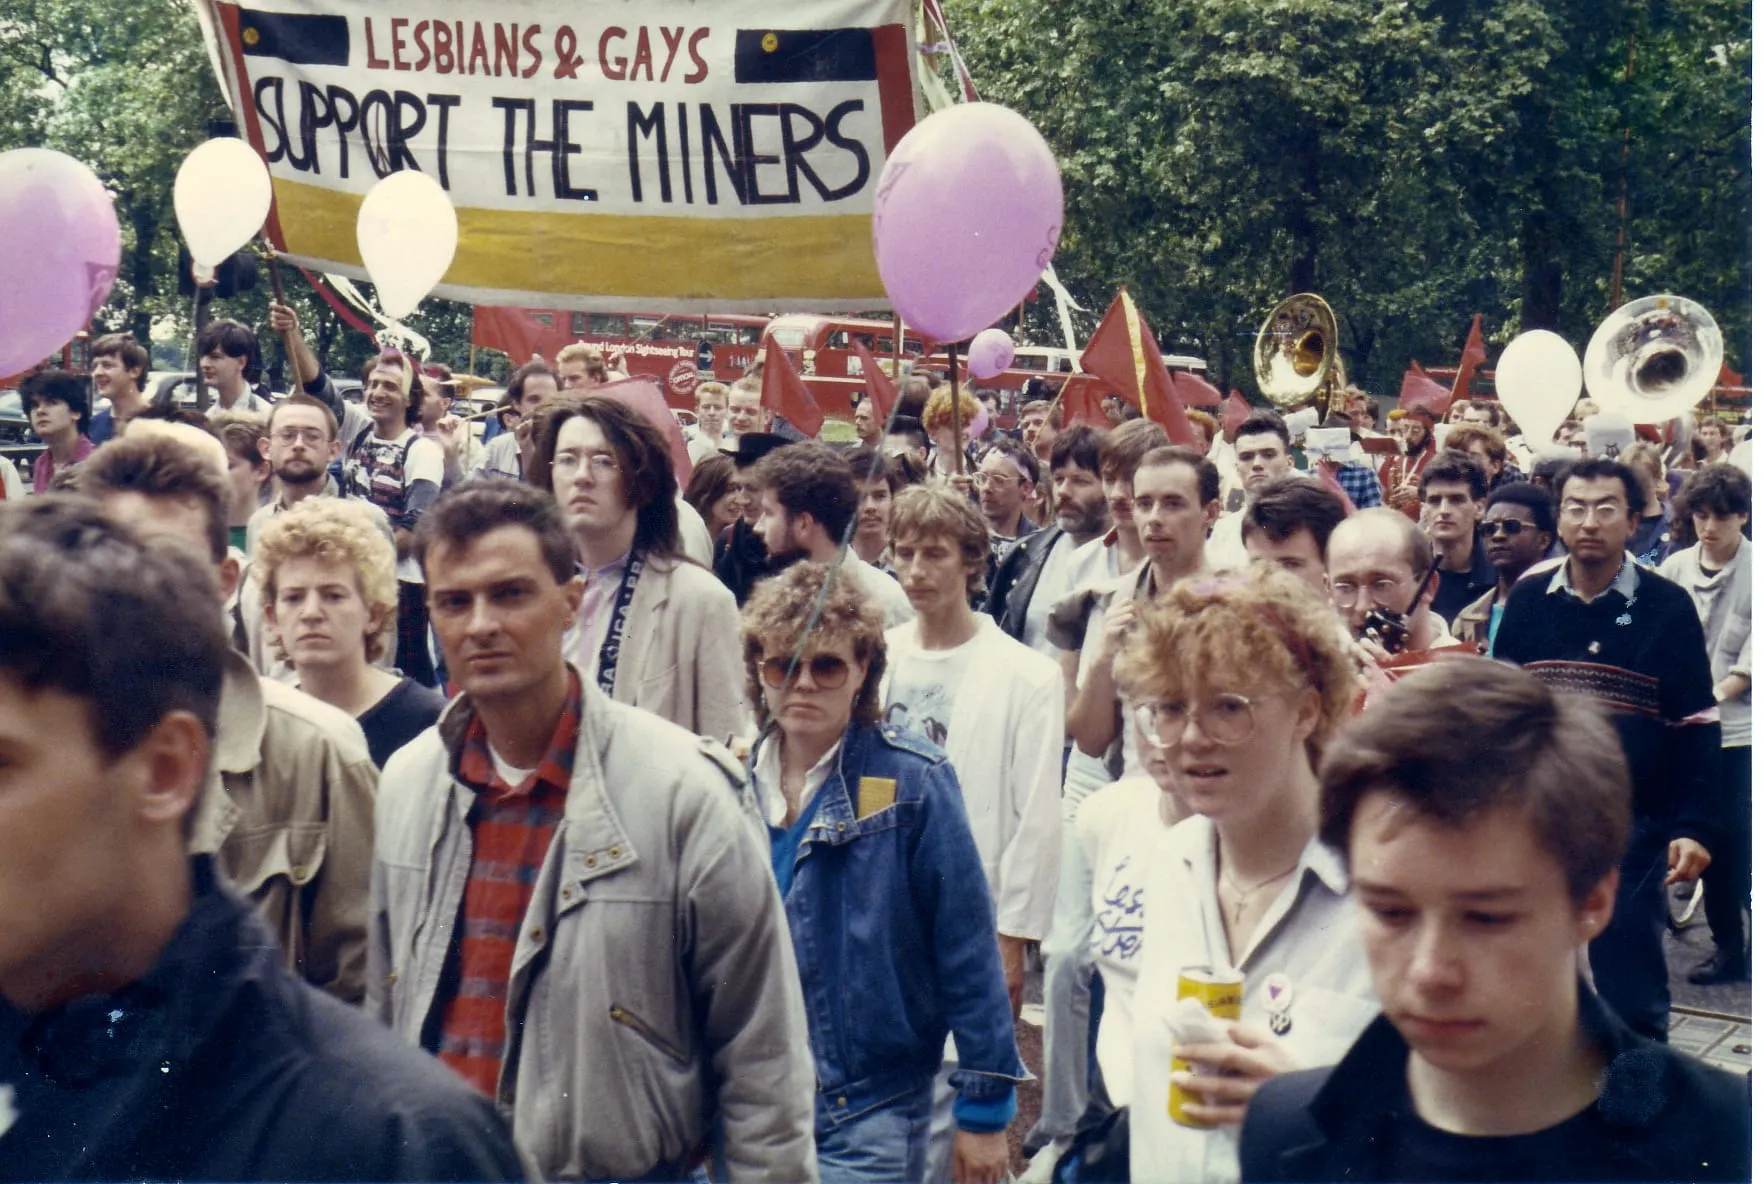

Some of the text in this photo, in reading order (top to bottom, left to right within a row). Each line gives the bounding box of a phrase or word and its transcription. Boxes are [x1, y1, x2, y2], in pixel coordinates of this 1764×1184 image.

[365, 17, 710, 84] LESBIANS & GAYS
[257, 77, 461, 190] SUPPORT
[493, 97, 598, 201] THE
[627, 101, 870, 204] MINERS
[605, 341, 635, 354] London
[635, 343, 679, 359] Sightseeing
[677, 346, 695, 358] Tour
